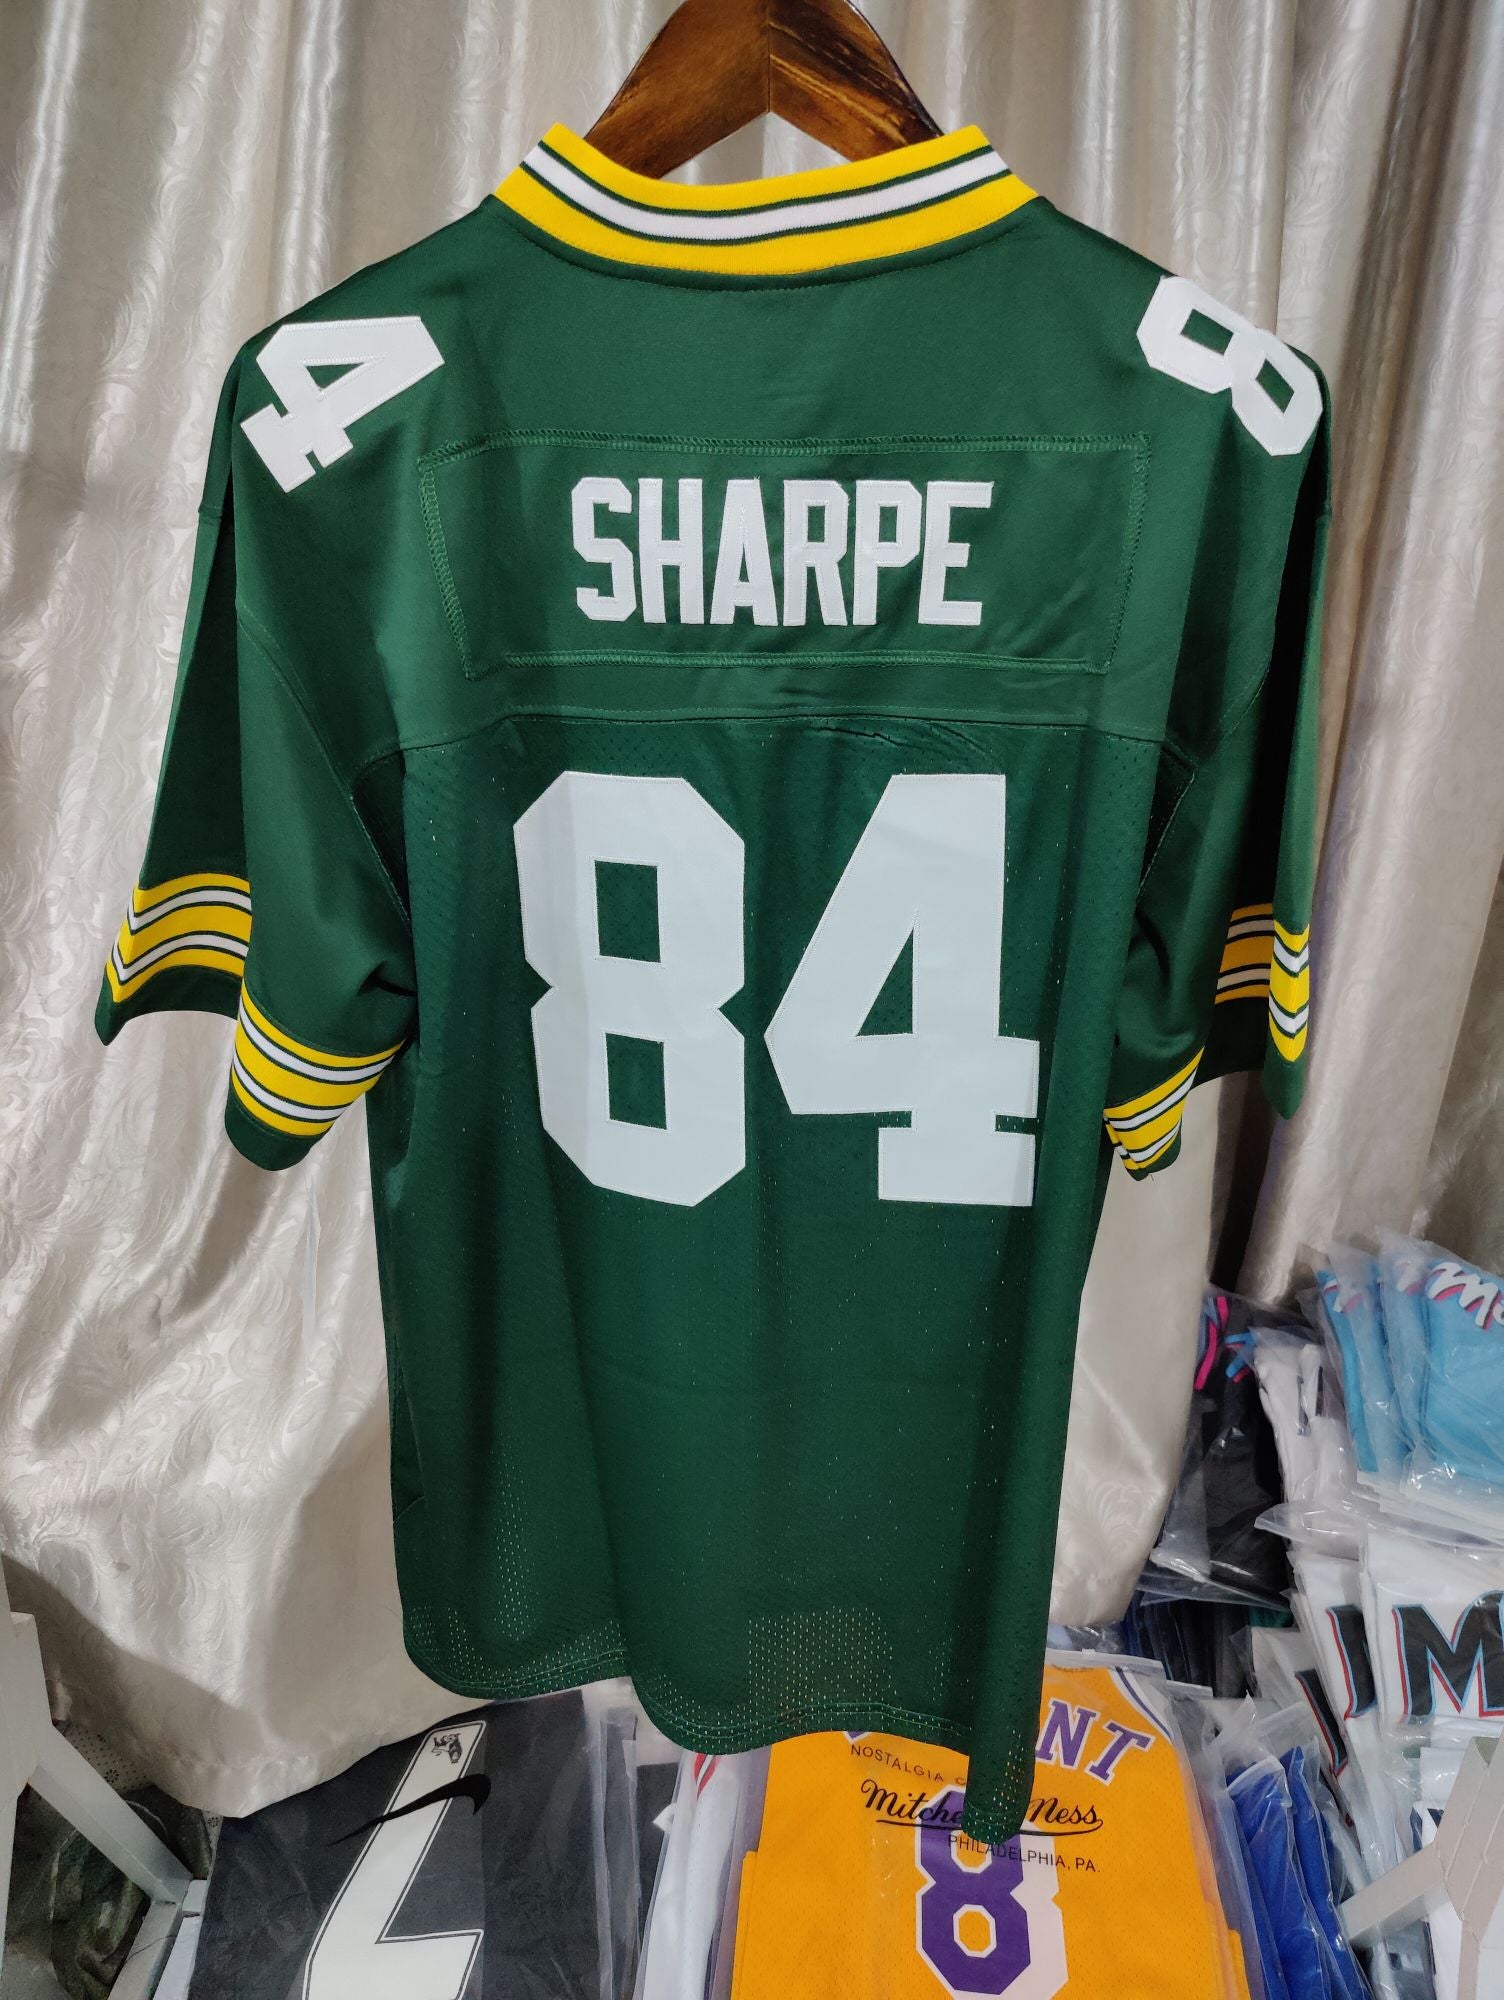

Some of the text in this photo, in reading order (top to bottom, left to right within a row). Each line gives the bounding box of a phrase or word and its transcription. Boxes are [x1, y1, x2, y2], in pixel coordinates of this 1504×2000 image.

[240, 316, 445, 493] 4
[1136, 275, 1324, 456] 8
[571, 476, 994, 627] SHARPE
[513, 770, 1040, 1207] 84
[850, 1743, 944, 1782] NOSTALGIA
[860, 1778, 1104, 1836] Mitche Ness
[1035, 1697, 1155, 1786] NT
[914, 1785, 1069, 2000] 8
